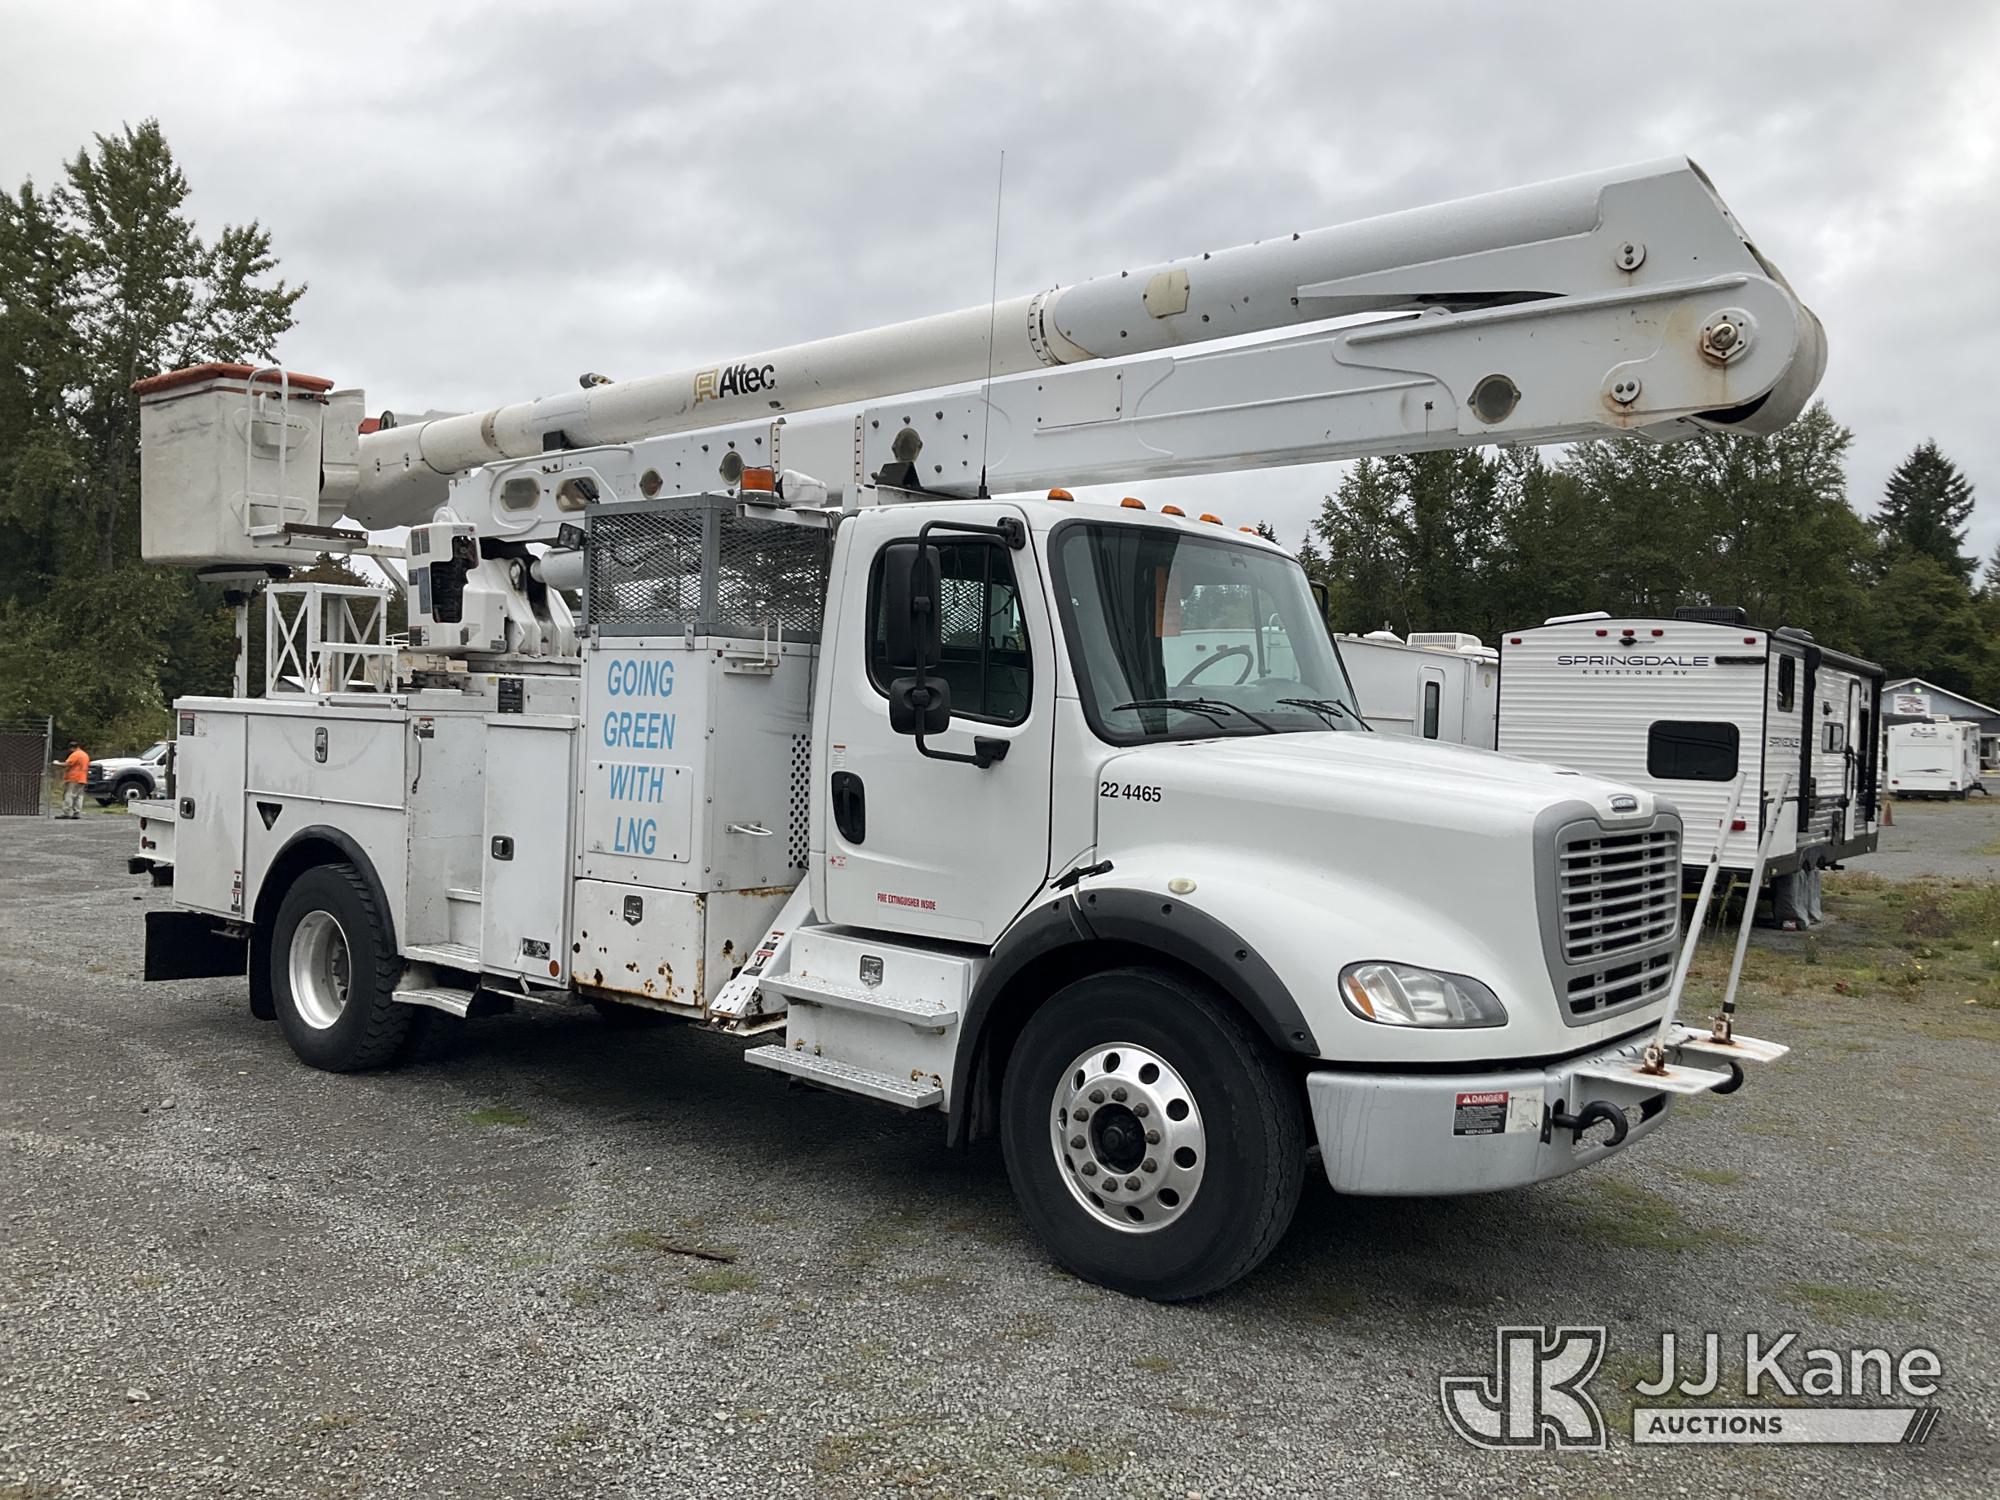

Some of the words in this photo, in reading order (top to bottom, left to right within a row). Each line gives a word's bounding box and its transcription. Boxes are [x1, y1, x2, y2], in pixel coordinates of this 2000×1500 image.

[719, 363, 775, 398] Altec
[608, 659, 674, 697] GOING
[1557, 655, 1709, 667] SPRINGDALE
[603, 711, 676, 750] GREEN
[609, 764, 665, 804] WITH
[1100, 781, 1119, 798] 22
[1121, 784, 1162, 803] 4465
[614, 816, 657, 855] LNG
[877, 892, 887, 903] FIRE
[888, 894, 919, 908] EXTINGUISHER
[920, 899, 936, 911] INSIDE
[1472, 1094, 1504, 1103] DANGER
